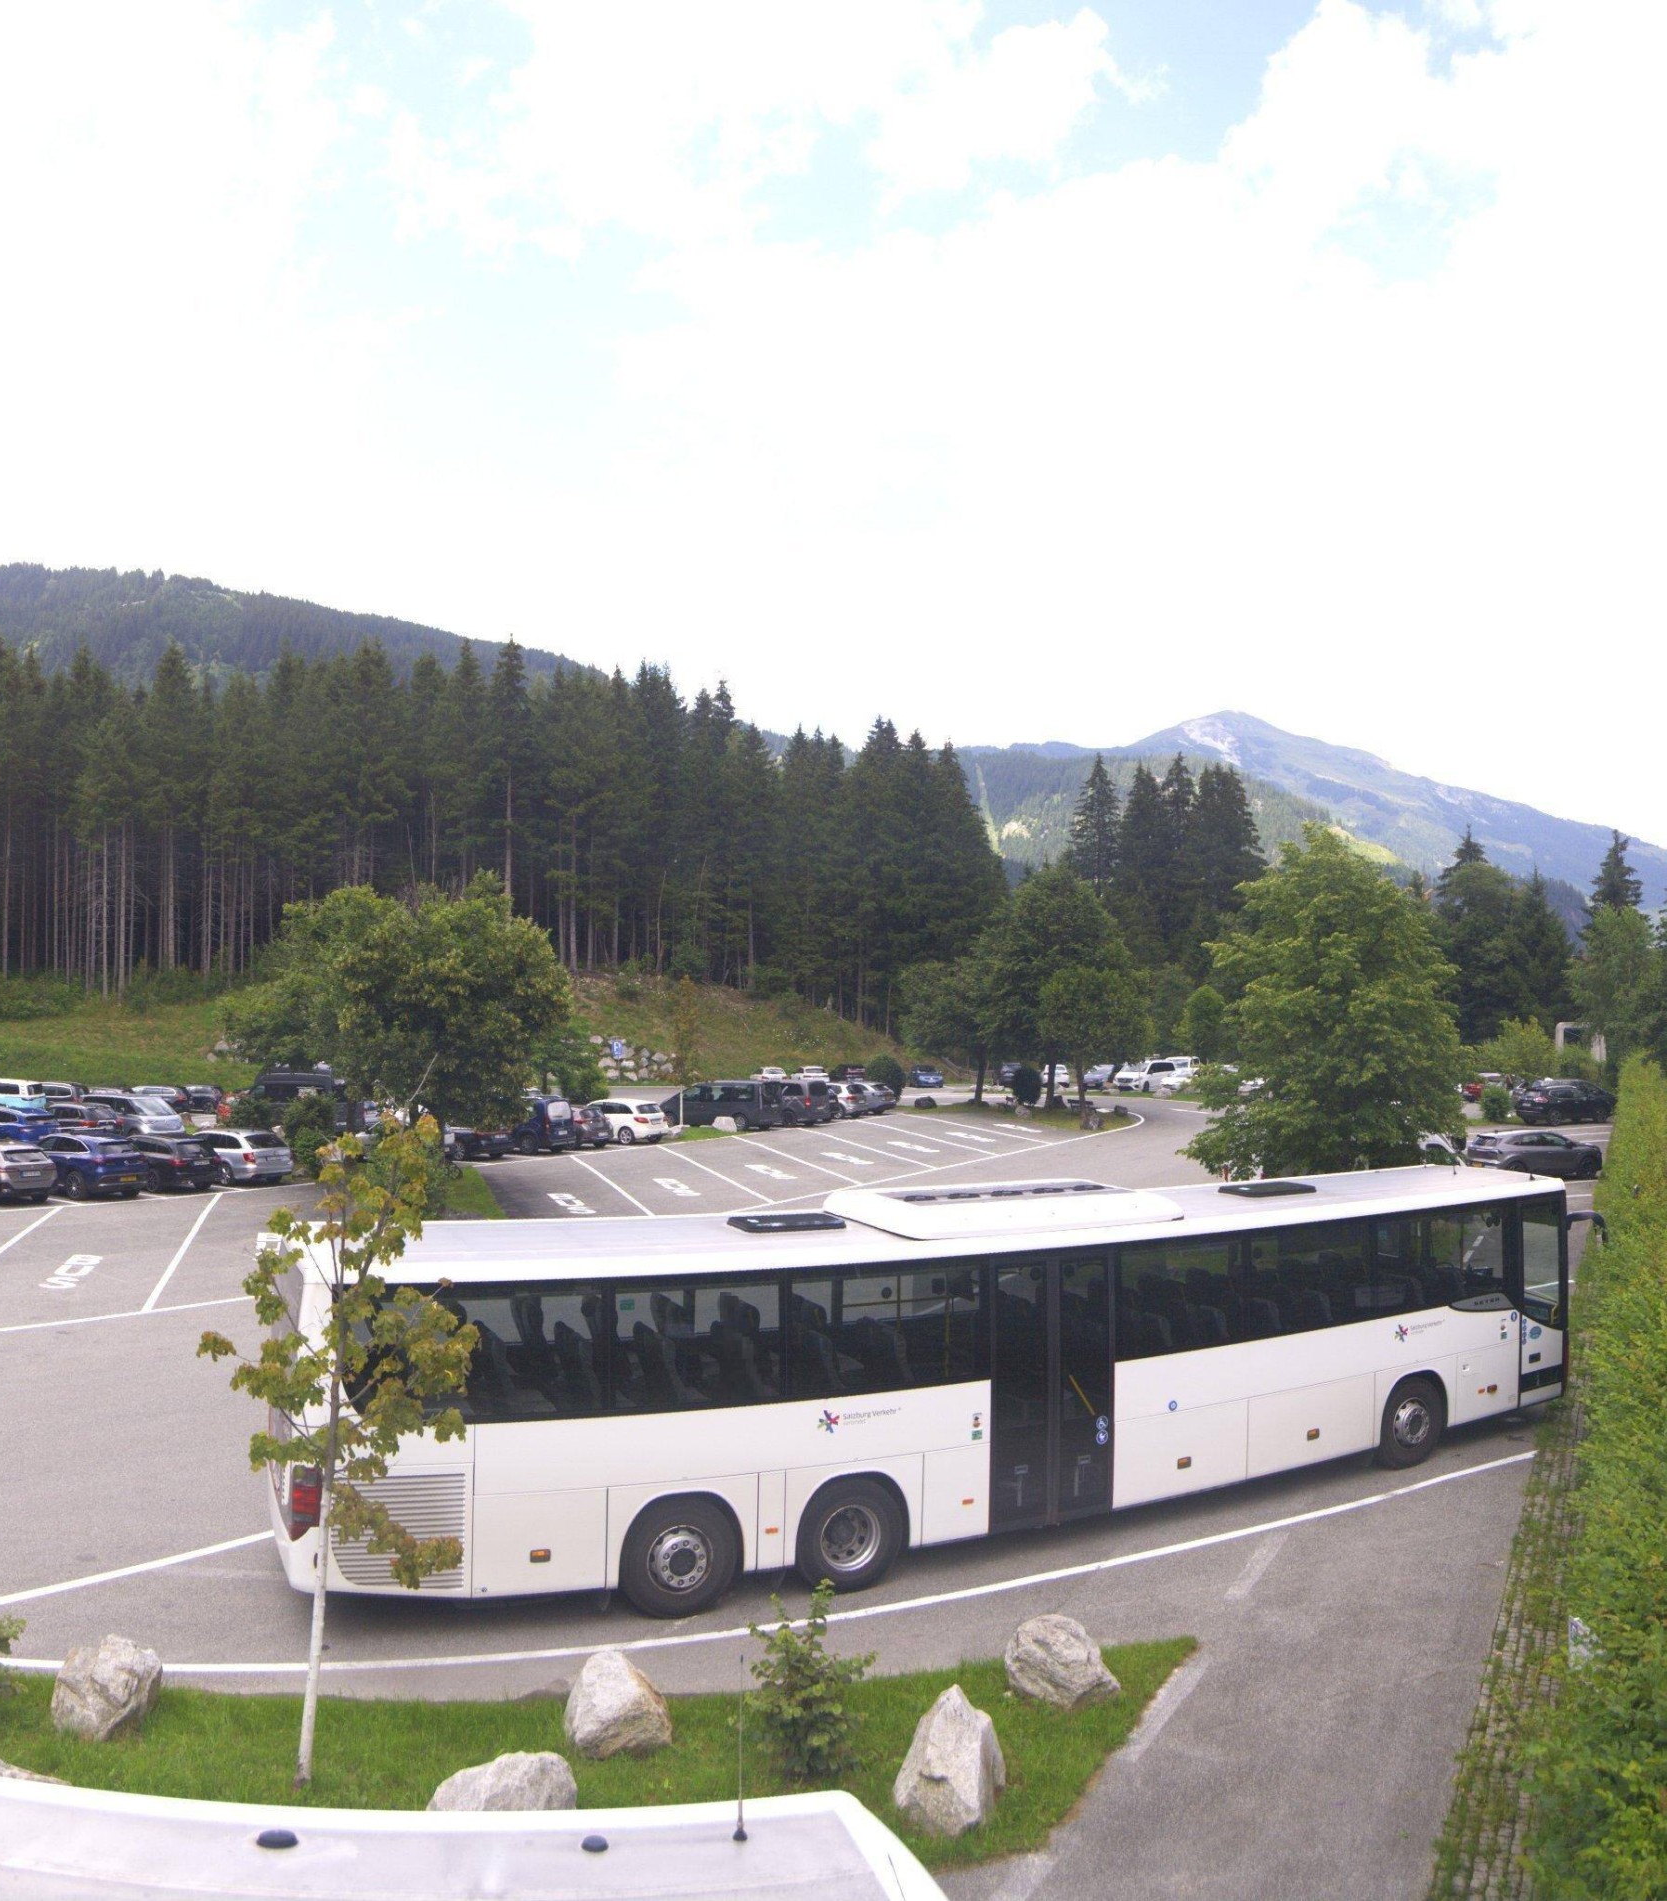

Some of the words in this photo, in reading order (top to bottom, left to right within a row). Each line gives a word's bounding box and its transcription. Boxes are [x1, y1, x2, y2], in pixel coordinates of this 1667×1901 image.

[39, 1254, 104, 1289] BUS
[843, 1411, 871, 1420] Salzburg
[872, 1408, 897, 1417] Verkehr
